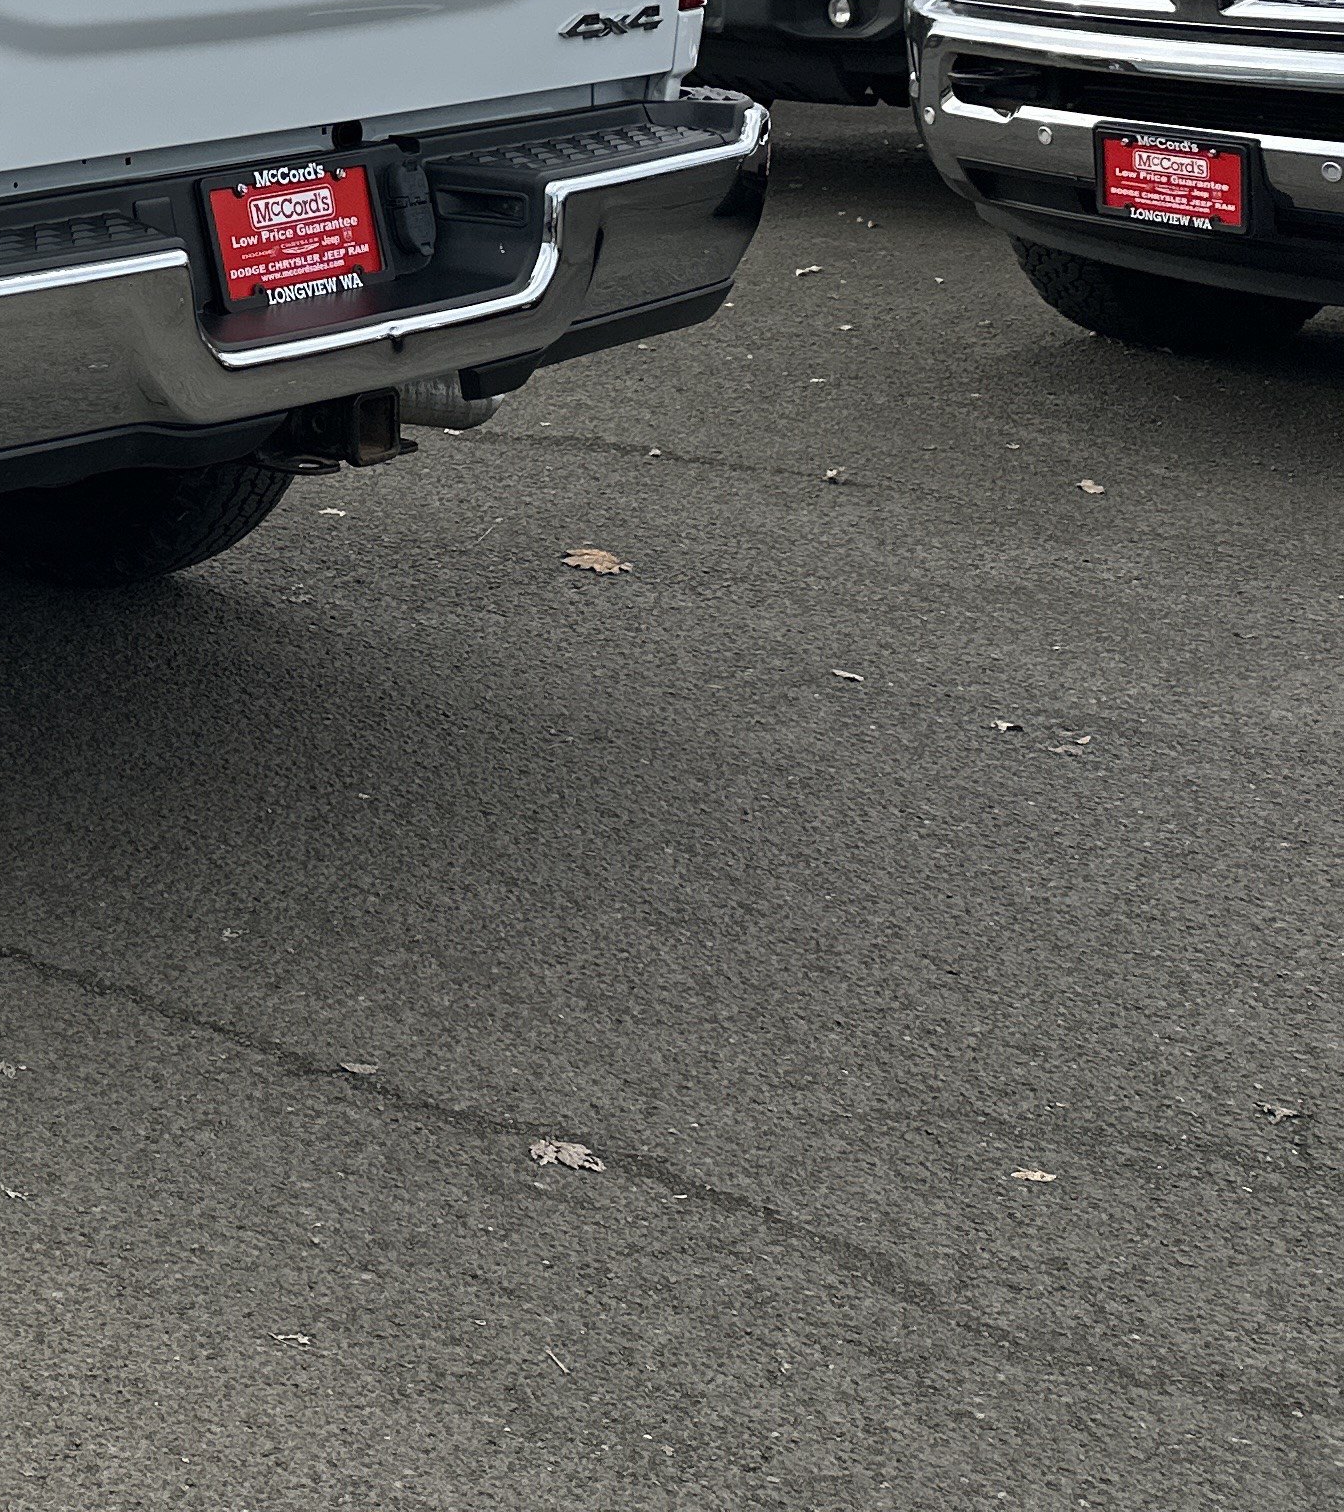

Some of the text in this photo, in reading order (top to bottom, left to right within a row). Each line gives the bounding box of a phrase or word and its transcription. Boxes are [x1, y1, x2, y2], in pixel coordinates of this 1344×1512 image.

[1136, 134, 1199, 153] McCord's
[254, 163, 325, 187] McCord's
[1137, 153, 1205, 175] McCord's
[1115, 168, 1137, 178] Low
[1139, 171, 1168, 183] Price
[1170, 175, 1230, 192] Guarantee
[253, 192, 330, 224] McCord's
[1130, 207, 1213, 230] LONGVIEW WA
[231, 216, 358, 248] Low Price Guarantee
[321, 235, 340, 246] Jeep
[230, 244, 370, 279] DODGE CHRYSLER JEEP RAM
[267, 273, 363, 304] LONGVIEW WA
